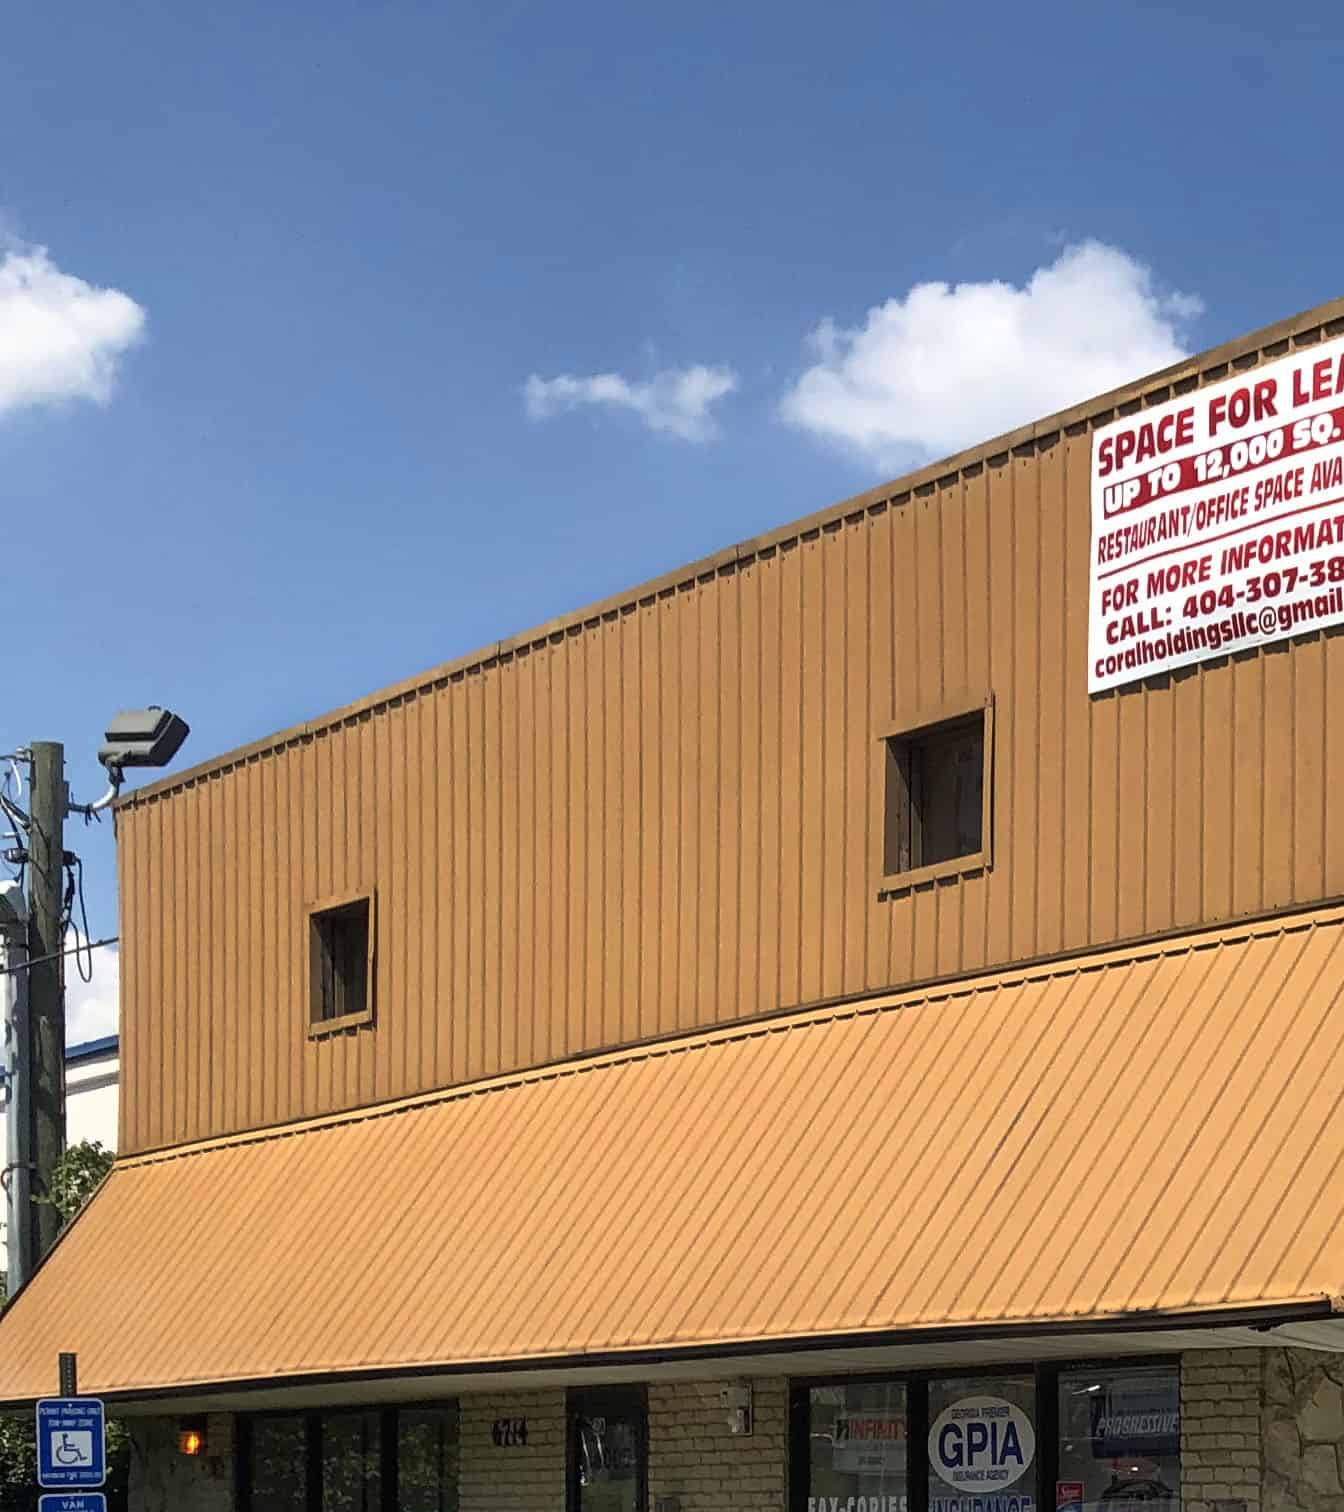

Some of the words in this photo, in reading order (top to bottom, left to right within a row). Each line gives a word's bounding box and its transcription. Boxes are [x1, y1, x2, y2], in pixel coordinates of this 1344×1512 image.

[1098, 406, 1194, 477] SPACE
[1208, 378, 1278, 437] FOR
[1105, 480, 1141, 516] UP
[1148, 463, 1181, 497] TO
[1194, 434, 1283, 483] 12,000
[1292, 413, 1341, 447] SQ.
[1098, 490, 1249, 565] RESTAURANT/OFFICE
[1254, 467, 1304, 512] SPACE
[1102, 579, 1139, 616] FOR
[1147, 555, 1212, 600] MORE
[1106, 605, 1172, 645] CALL:
[939, 1421, 1024, 1469] GPIA
[1096, 1414, 1178, 1439] PROGRESSIVE
[61, 1499, 85, 1510] VAN
